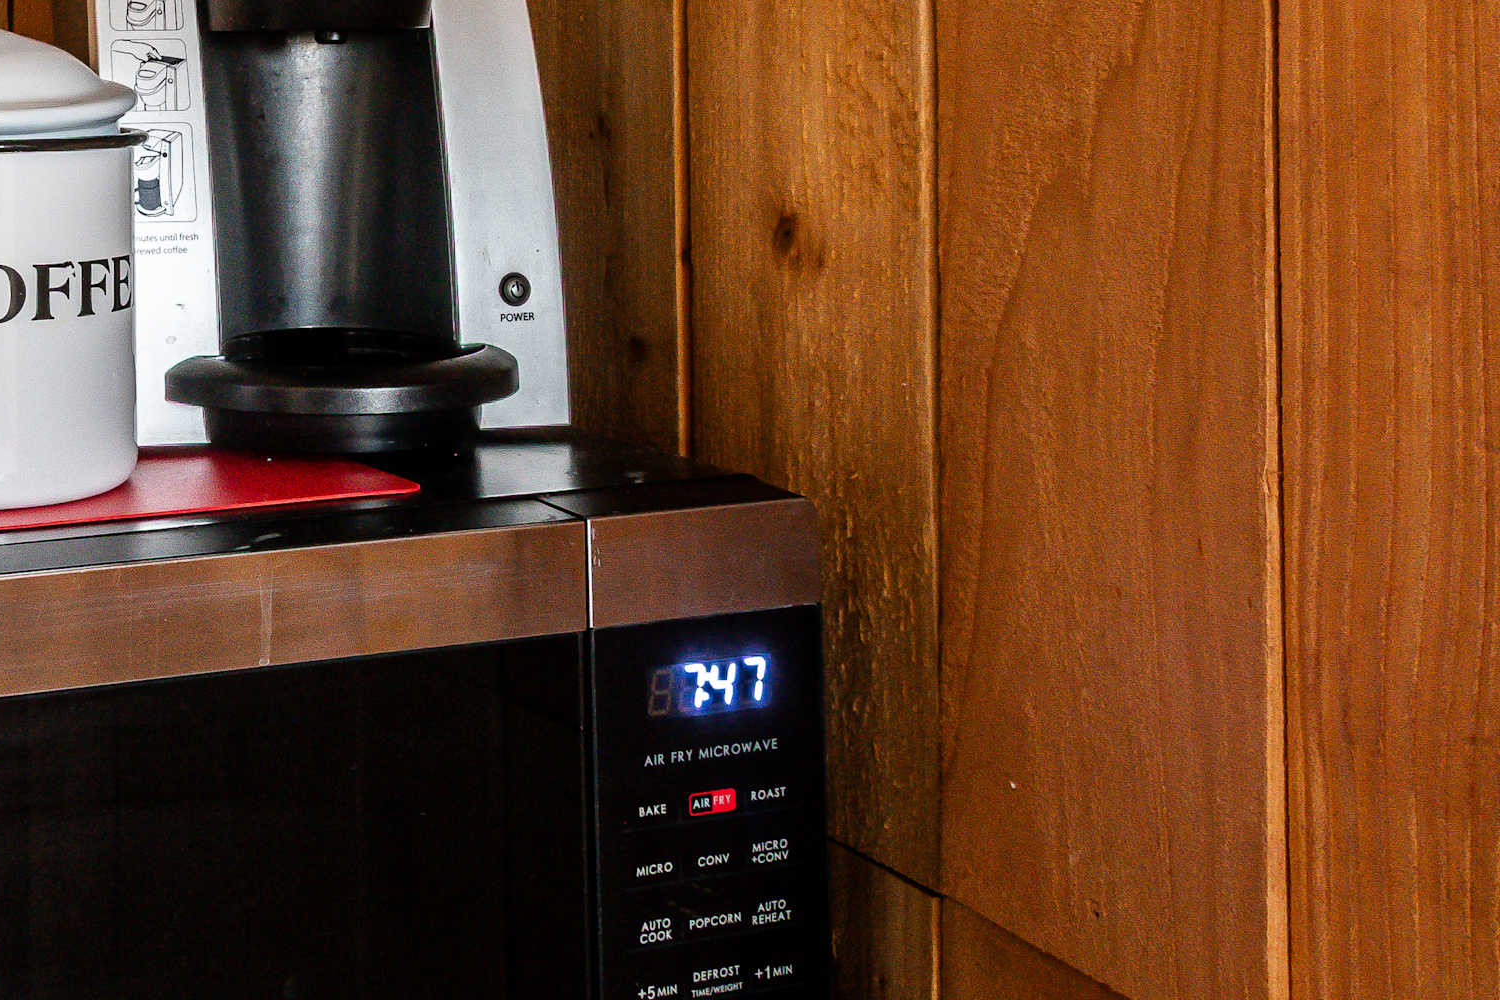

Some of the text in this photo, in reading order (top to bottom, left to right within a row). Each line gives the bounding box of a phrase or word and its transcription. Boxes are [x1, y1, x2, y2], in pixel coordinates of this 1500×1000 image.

[159, 232, 178, 241] until
[179, 231, 199, 241] fresh
[163, 245, 188, 254] coffee
[500, 311, 535, 322] POWER
[684, 655, 767, 709] 7:47
[644, 738, 779, 767] AIR FRY MICROWAVE
[751, 786, 787, 801] ROAST
[692, 794, 732, 810] AIR FRY
[638, 804, 667, 818] BAKE
[752, 838, 788, 853] MICRO
[697, 853, 730, 867] CONV
[751, 850, 789, 864] +CONV
[636, 861, 673, 878] MICRO
[757, 899, 787, 913] AUTO
[641, 917, 671, 932] AUTO
[689, 912, 742, 930] POPCORN
[752, 909, 792, 926] REHEAT
[639, 929, 673, 944] COOK
[693, 965, 740, 983] DEFROST
[691, 981, 744, 998] TIME/WEIGHT
